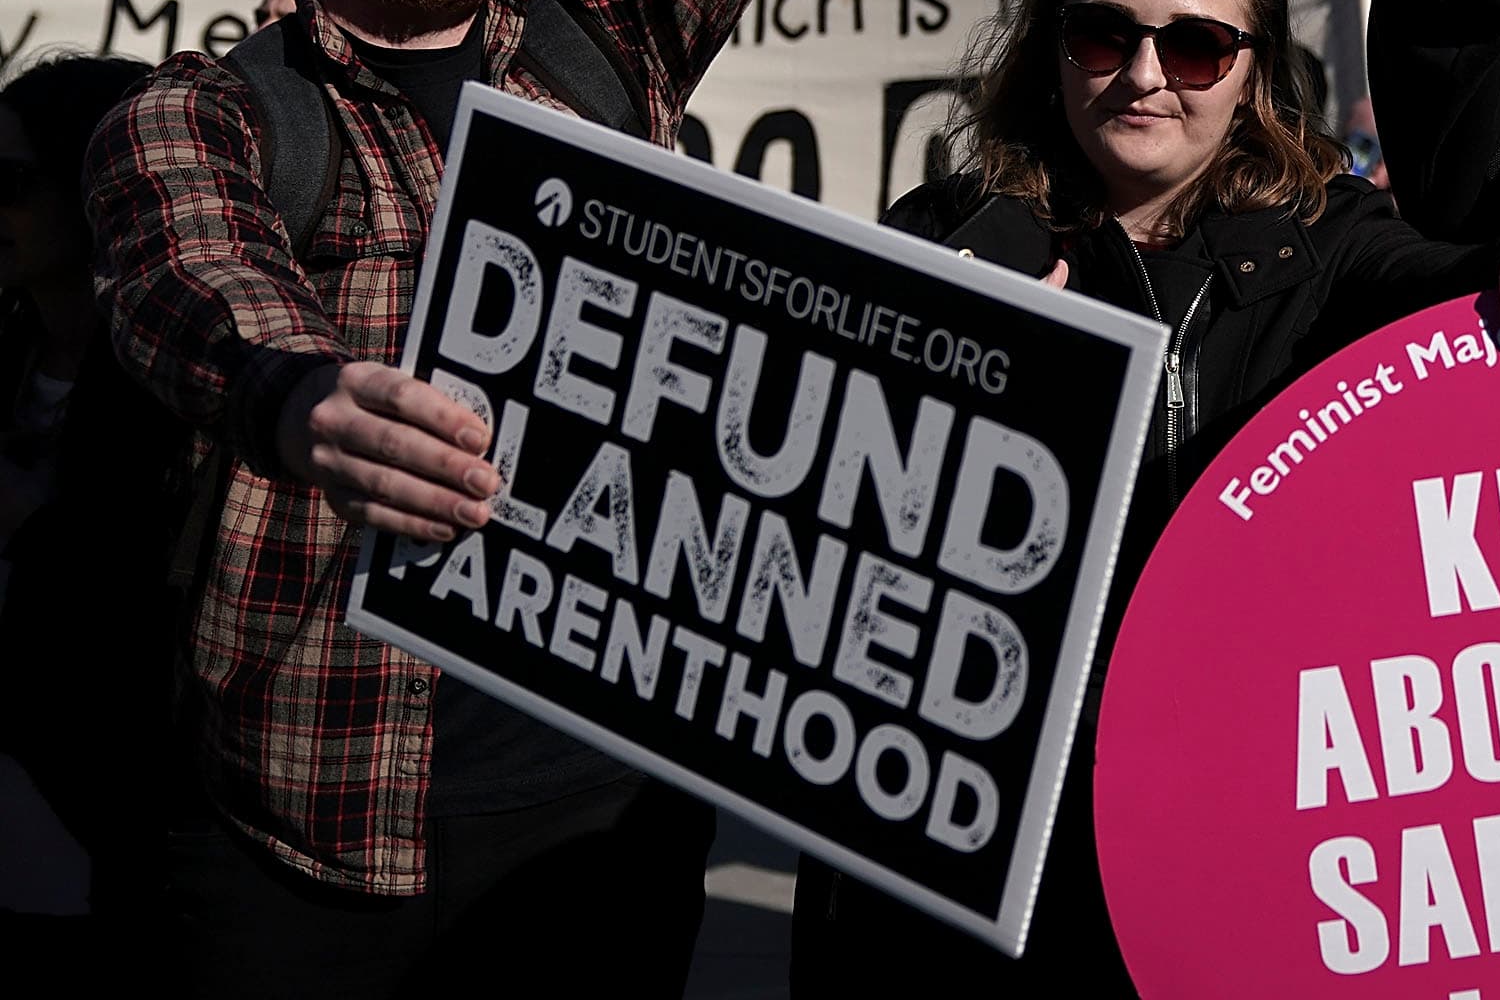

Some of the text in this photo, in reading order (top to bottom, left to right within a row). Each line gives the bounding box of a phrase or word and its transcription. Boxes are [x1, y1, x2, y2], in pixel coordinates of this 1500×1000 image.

[579, 200, 1010, 394] STUDENTSFORLIFE.ORG
[437, 219, 1069, 594] DEFUND
[1219, 362, 1403, 521] Feminist
